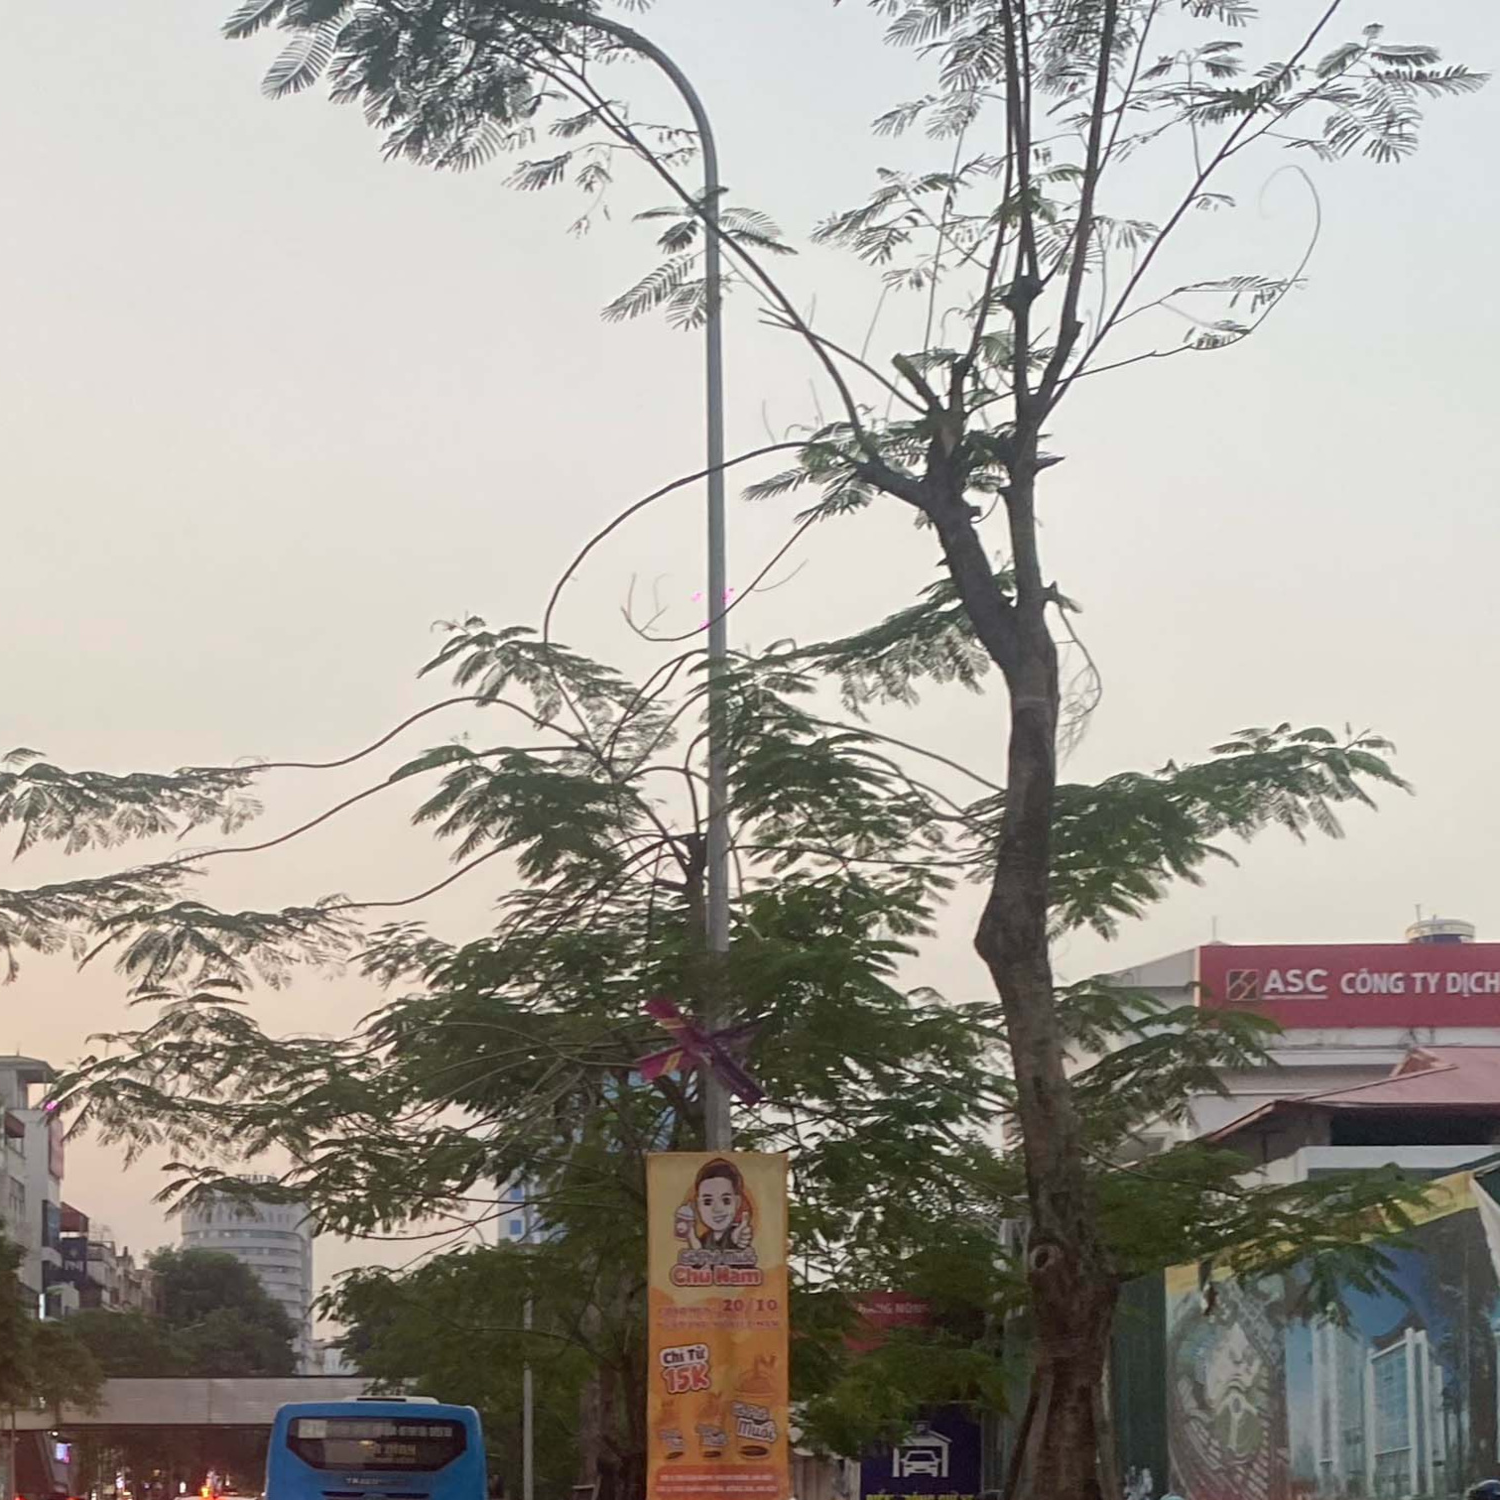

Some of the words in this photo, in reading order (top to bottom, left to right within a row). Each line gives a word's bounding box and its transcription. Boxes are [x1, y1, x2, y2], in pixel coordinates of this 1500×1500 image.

[1263, 969, 1328, 993] ASC
[1341, 968, 1404, 994] CÔNG
[1411, 972, 1440, 994] TY
[1446, 972, 1500, 997] DỊCH
[665, 1363, 709, 1391] 15K
